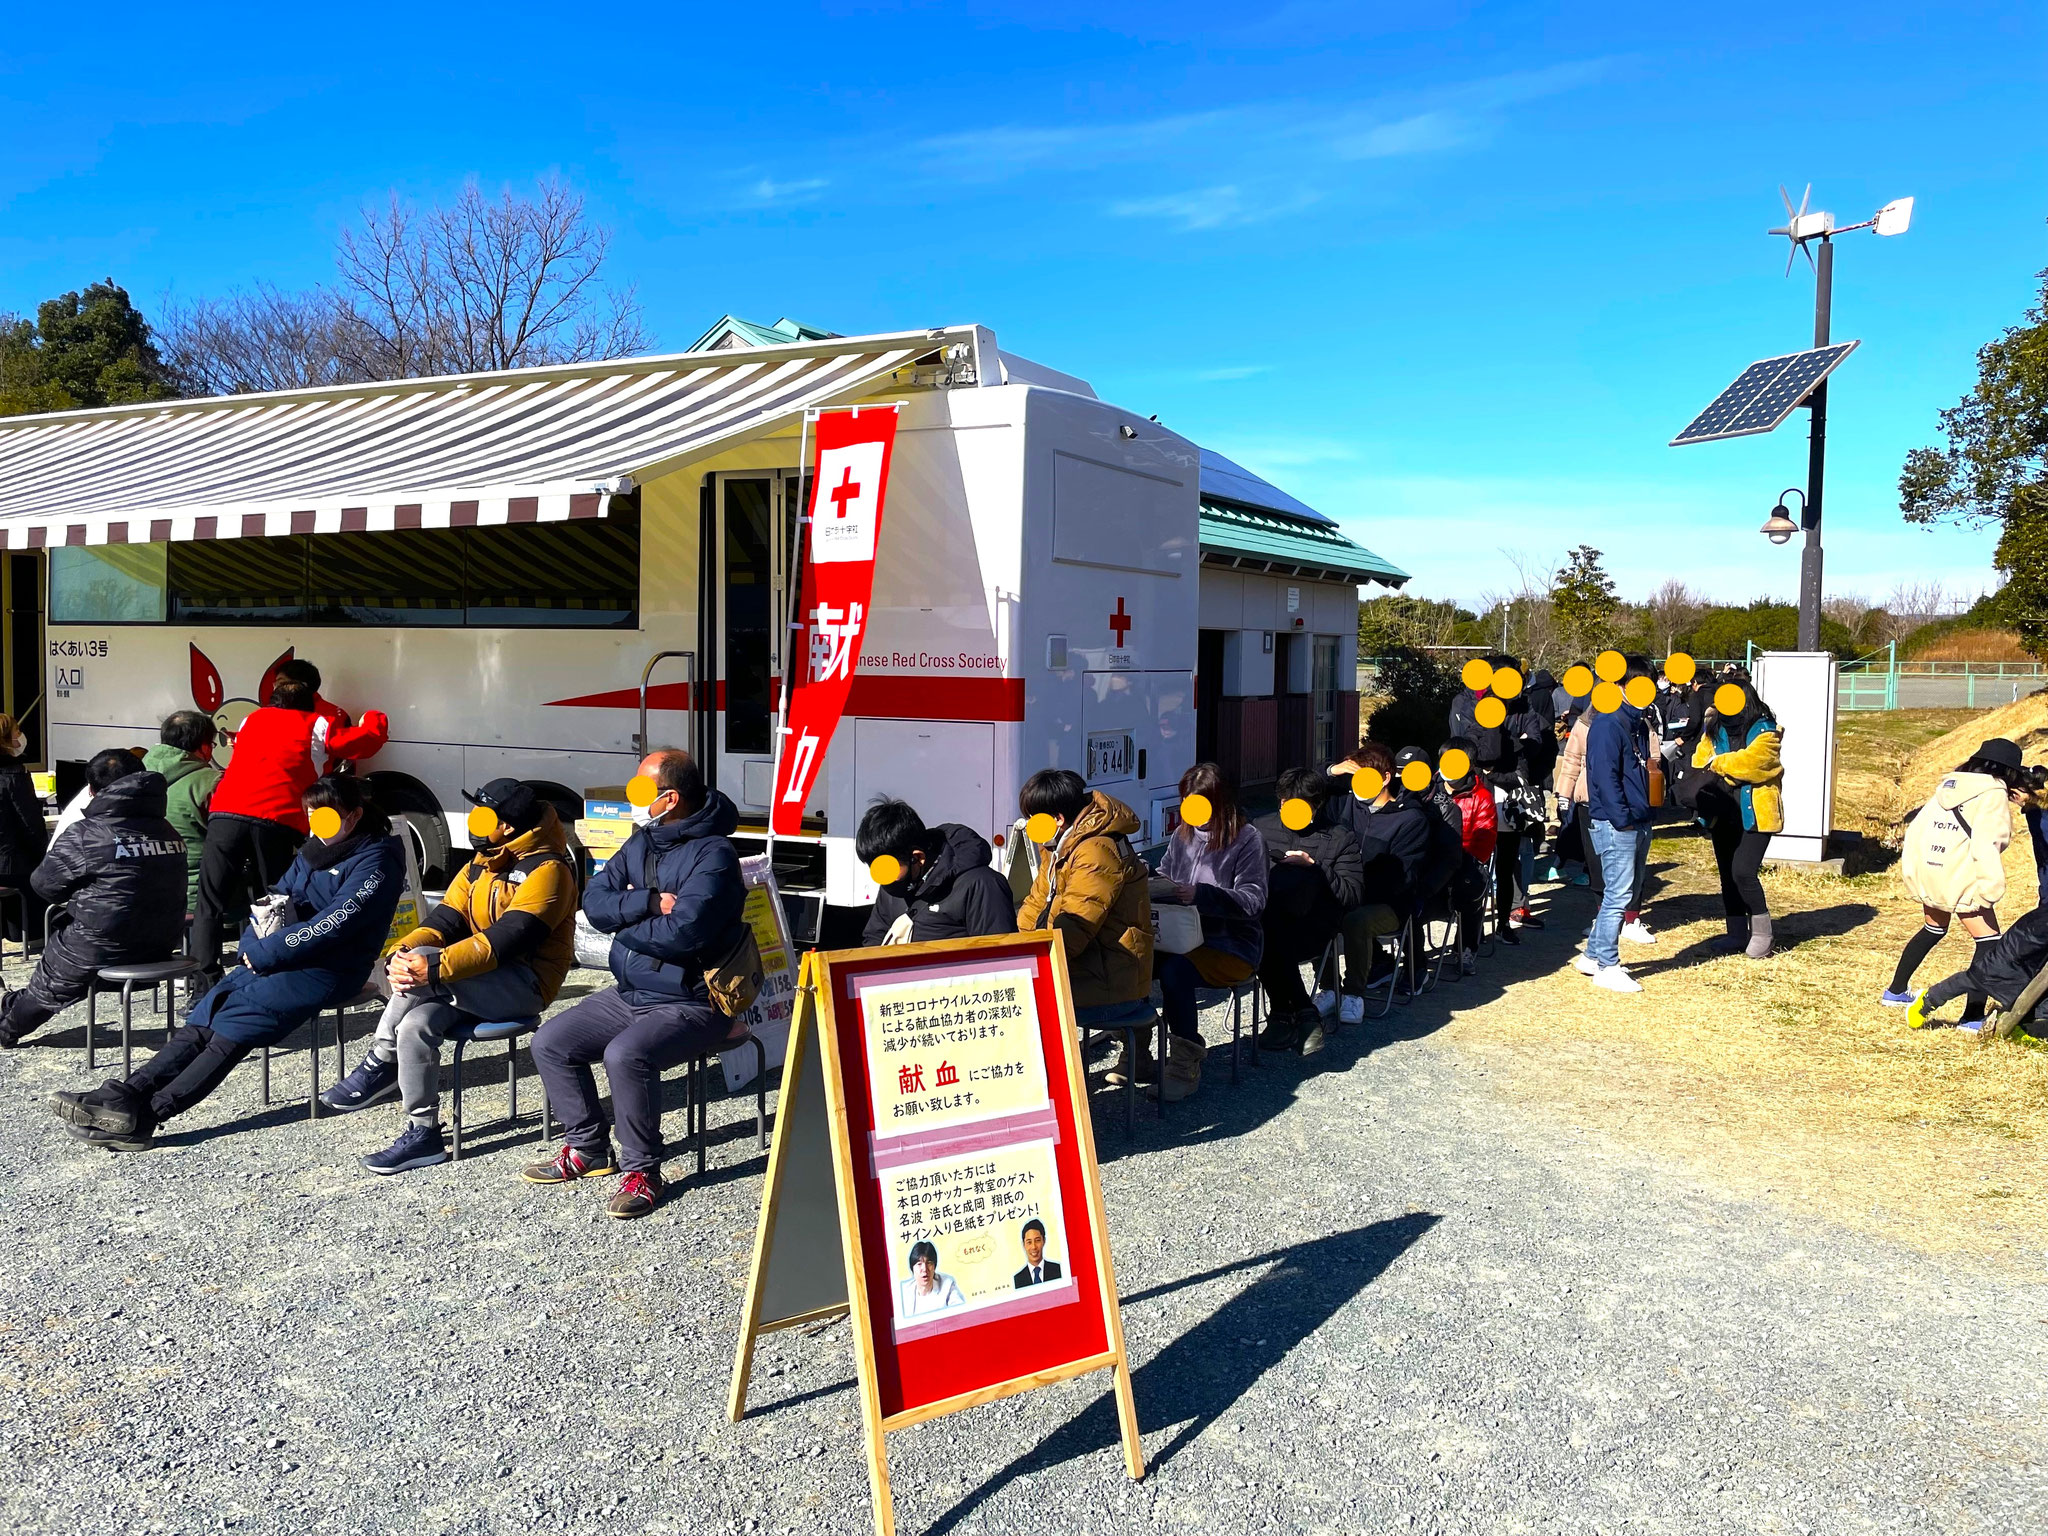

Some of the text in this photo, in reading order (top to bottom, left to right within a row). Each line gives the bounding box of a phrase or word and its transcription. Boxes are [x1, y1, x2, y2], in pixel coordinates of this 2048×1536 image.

[50, 640, 108, 657] はくあい3号
[855, 653, 1007, 672] nese Red Cross Society
[58, 668, 80, 685] 入口
[285, 868, 386, 948] new balance
[879, 987, 1016, 1018] 新型コロナウイルスの影響
[882, 1005, 1022, 1034] による献血協力者の深刻な
[883, 1024, 1005, 1052] 減少が続いております。
[969, 1061, 1025, 1082] にご協力を
[893, 1091, 980, 1117] お願い致します。
[896, 1162, 997, 1192] ご協力頂いた方には
[897, 1171, 1035, 1210] 本日のサッカー教室のゲスト
[900, 1202, 1040, 1243] サイン入り色紙をプレゼント!
